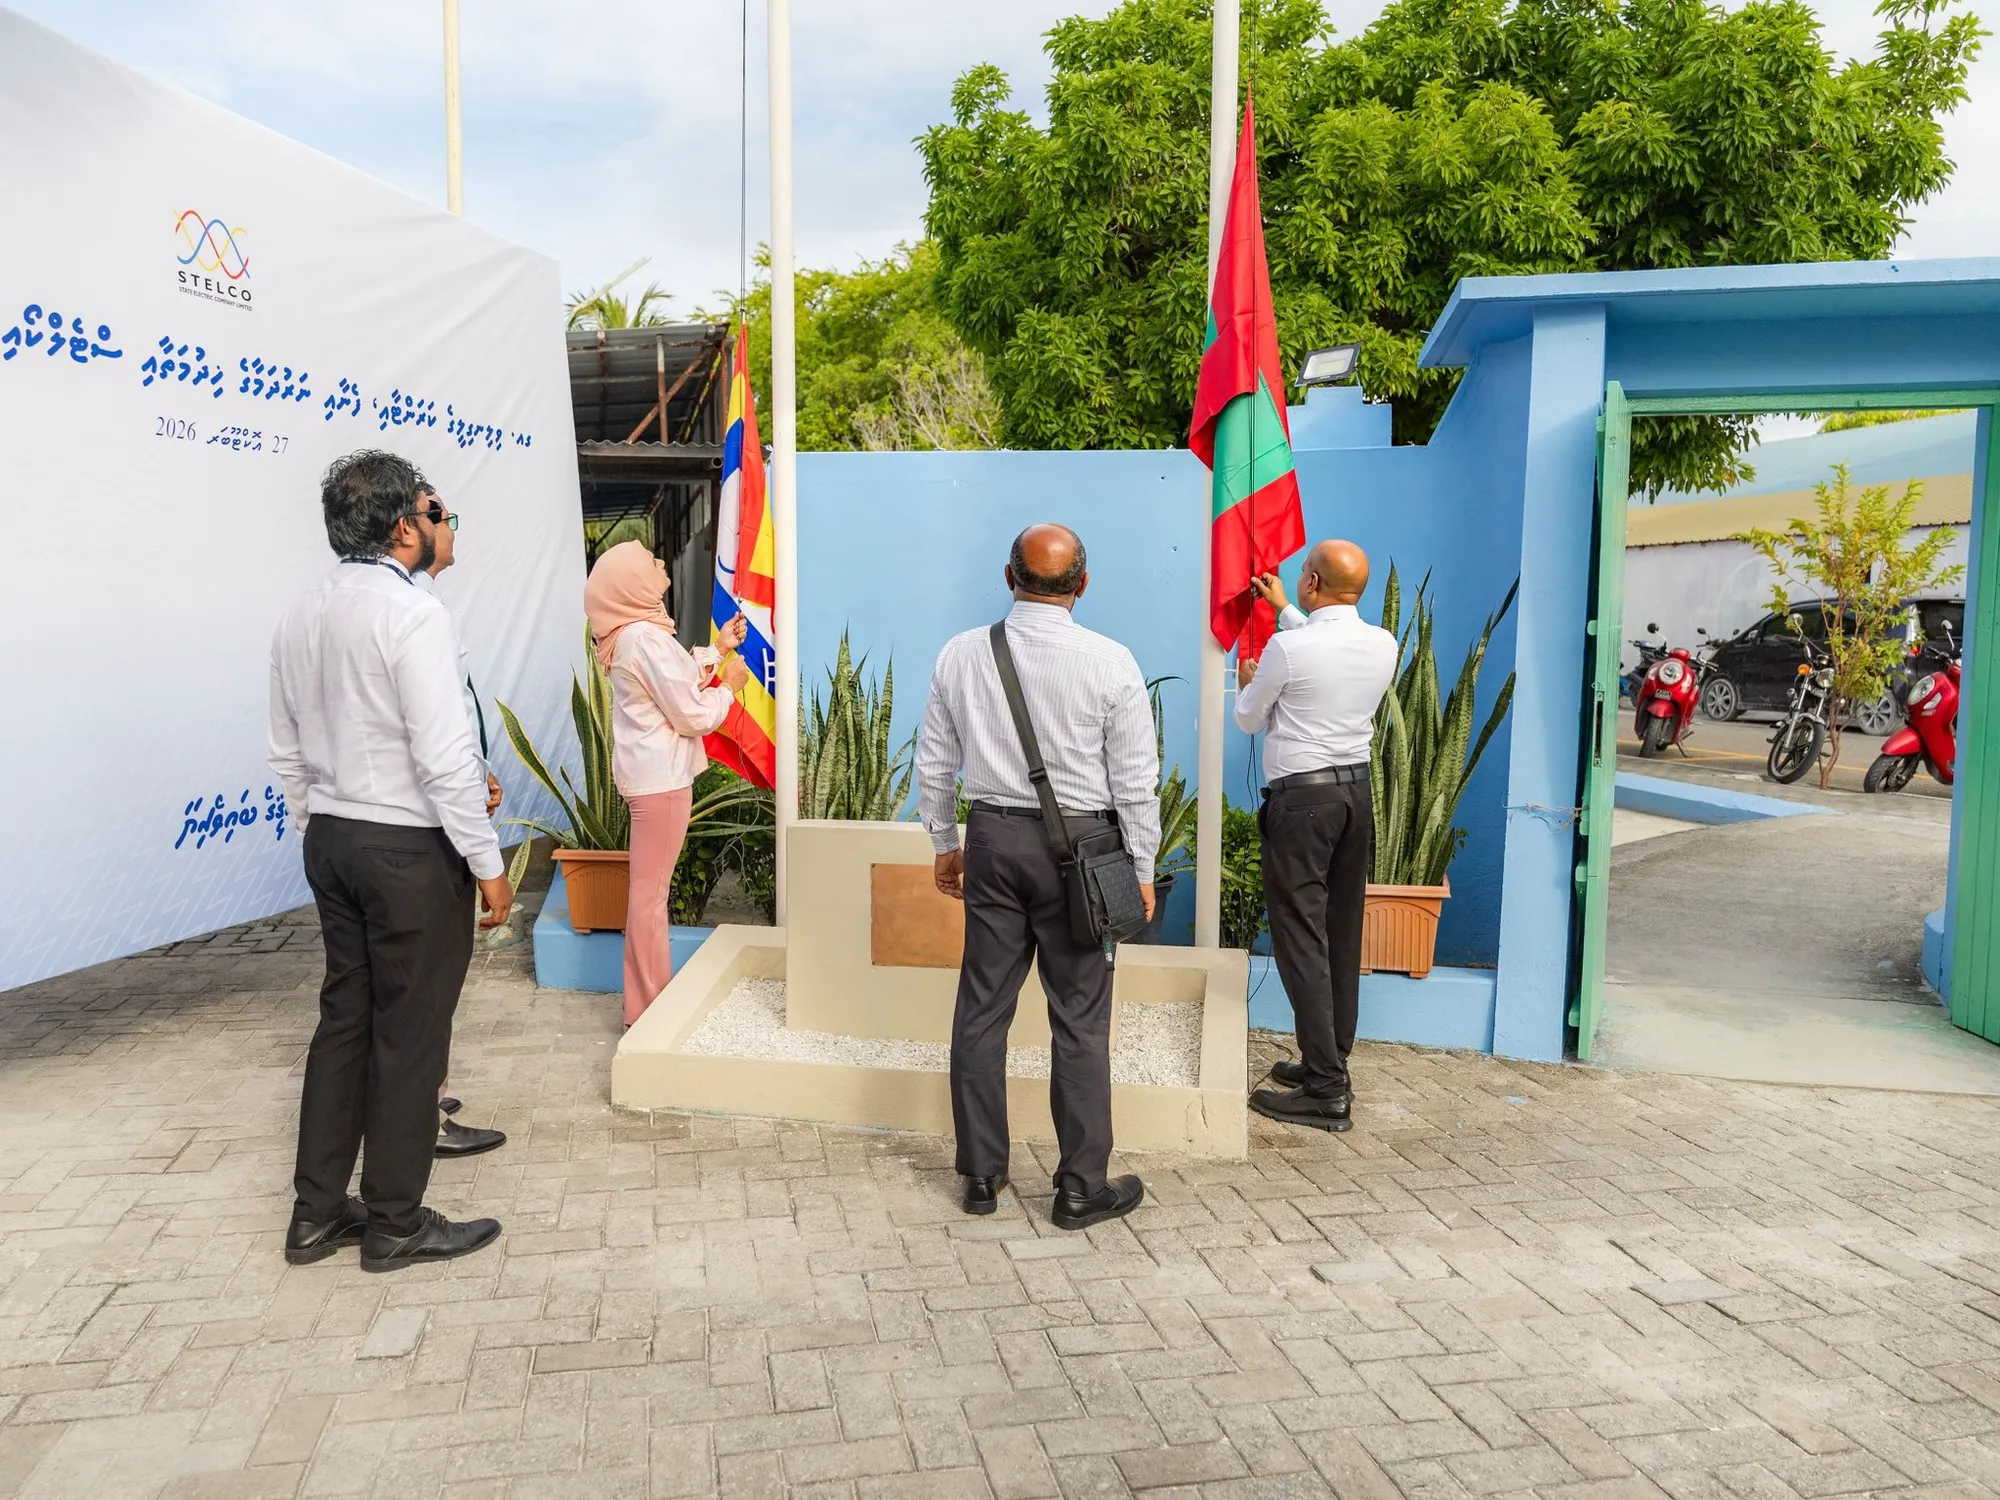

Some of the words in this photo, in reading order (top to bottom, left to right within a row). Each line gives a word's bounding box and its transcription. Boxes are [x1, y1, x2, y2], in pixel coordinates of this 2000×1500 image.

[178, 270, 252, 302] STELCO
[179, 286, 193, 296] STATE
[193, 290, 213, 301] ELECTRIC
[214, 297, 236, 307] COMPANY
[236, 303, 253, 312] LIMITED
[155, 416, 197, 441] 2026
[272, 435, 289, 454] 27
